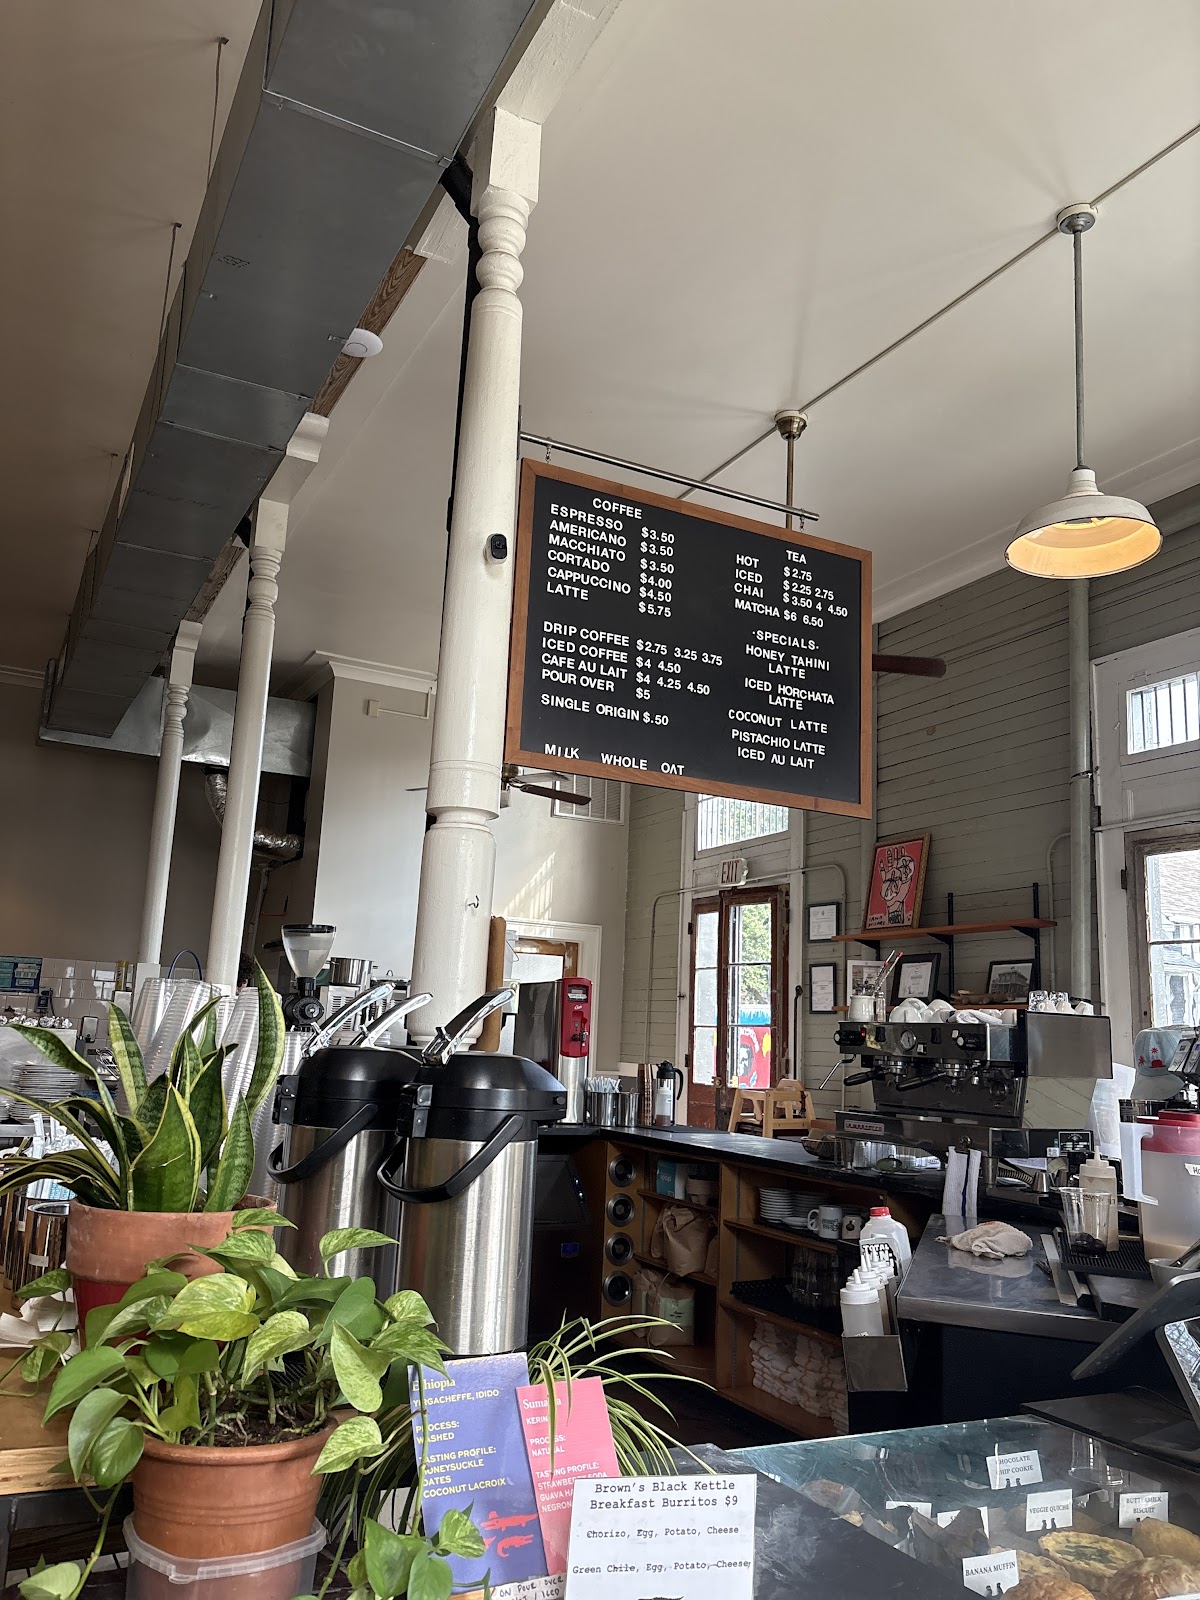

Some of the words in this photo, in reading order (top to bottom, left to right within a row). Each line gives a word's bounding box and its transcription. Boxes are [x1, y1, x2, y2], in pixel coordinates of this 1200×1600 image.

[593, 498, 642, 519] COFFEE
[551, 504, 623, 531] ESPRESSO
[642, 527, 674, 543] $3.50
[550, 520, 626, 547] AMERICANO
[640, 541, 673, 556] $3.50
[549, 534, 625, 561] MACCHIATO
[640, 558, 674, 573] $3.50
[737, 554, 759, 568] HOT
[786, 550, 806, 564] TEA
[548, 550, 610, 572] CORTADO
[640, 572, 672, 589] $4.00
[548, 567, 631, 594] CAPPUCCINO
[639, 586, 671, 602] $4.50
[736, 569, 762, 583] ICED
[815, 588, 834, 600] 2.75
[547, 582, 588, 600] LATTE
[639, 601, 671, 617] $5.75
[734, 583, 763, 598] CHAI
[816, 602, 822, 611] 4
[828, 605, 847, 617] 4.50
[735, 598, 780, 617] MATCHA
[784, 610, 797, 621] $6
[803, 615, 823, 627] 6.50
[544, 621, 577, 636] DRIP
[580, 629, 629, 646] COFFEE
[636, 639, 667, 655] $2.75
[674, 647, 697, 660] 3.25
[702, 653, 722, 666] 3.75
[543, 637, 575, 652] ICED
[579, 645, 627, 663] COFFEE
[636, 656, 651, 668] $4
[658, 661, 681, 673] 4.50
[746, 644, 785, 662] HONEY
[791, 655, 829, 670] TAHINI
[542, 653, 575, 669] CAFE
[578, 660, 596, 672] AU
[600, 664, 627, 679] LAIT
[636, 671, 650, 684] $4
[657, 677, 681, 690] 4.25
[687, 682, 710, 695] 4.50
[769, 663, 805, 679] LATTE
[542, 669, 576, 685] POUR
[580, 676, 614, 692] OVER
[636, 687, 650, 699] $5
[745, 678, 772, 691] ICED
[778, 684, 834, 704] HORCHATA
[541, 694, 590, 712] SINGLE
[596, 704, 639, 720] ORIGIN
[643, 711, 668, 725] $.50
[769, 695, 803, 710] LATTE
[729, 709, 782, 727] COCONUT
[791, 719, 827, 733] LATTE
[732, 729, 790, 748] PISTACHIO
[794, 740, 825, 755] LATTE
[544, 744, 579, 759] MILK
[601, 753, 647, 770] WHOLE
[661, 763, 684, 775] OAT
[738, 747, 765, 761] ICED
[771, 754, 785, 765] AU
[791, 756, 814, 769] LAIT
[721, 860, 740, 884] EXIT
[412, 1379, 456, 1392] Ehiopia
[476, 1389, 500, 1399] IDIDO
[522, 1398, 562, 1410] Sumaa
[526, 1415, 549, 1425] KERIN
[529, 1434, 566, 1446] PROCSS:
[419, 1452, 456, 1463] ASTING
[458, 1446, 497, 1459] PROFILE:
[532, 1445, 565, 1457] NATUAL
[567, 1461, 600, 1474] PROFILE:
[997, 1455, 1031, 1465] HOCOLATE
[1011, 1465, 1034, 1474] COOKIE
[423, 1483, 467, 1499] COCONUT
[468, 1477, 506, 1491] LACROIX
[594, 1482, 645, 1493] Brown's
[652, 1480, 688, 1492] Black
[693, 1479, 736, 1491] Kettle
[539, 1491, 564, 1502] GUAVA
[589, 1498, 656, 1510] Breakfast
[661, 1496, 718, 1508] Burritos
[724, 1495, 738, 1507] $9
[1126, 1496, 1162, 1504] BUTTRMILK
[541, 1500, 573, 1513] NEGRON
[1029, 1506, 1049, 1514] VEGGIE
[1049, 1504, 1070, 1513] QUICHE
[586, 1529, 631, 1539] Chorizo,
[636, 1528, 658, 1539] Egg,
[664, 1527, 702, 1537] Potato,
[706, 1525, 740, 1535] Cheese
[572, 1565, 602, 1575] Green
[606, 1564, 640, 1574] Chile,
[645, 1563, 667, 1574] Egg,
[673, 1561, 711, 1571] Potato,
[965, 1565, 993, 1577] BANANA
[992, 1561, 1016, 1573] MUFFIN
[499, 1588, 512, 1598] ON
